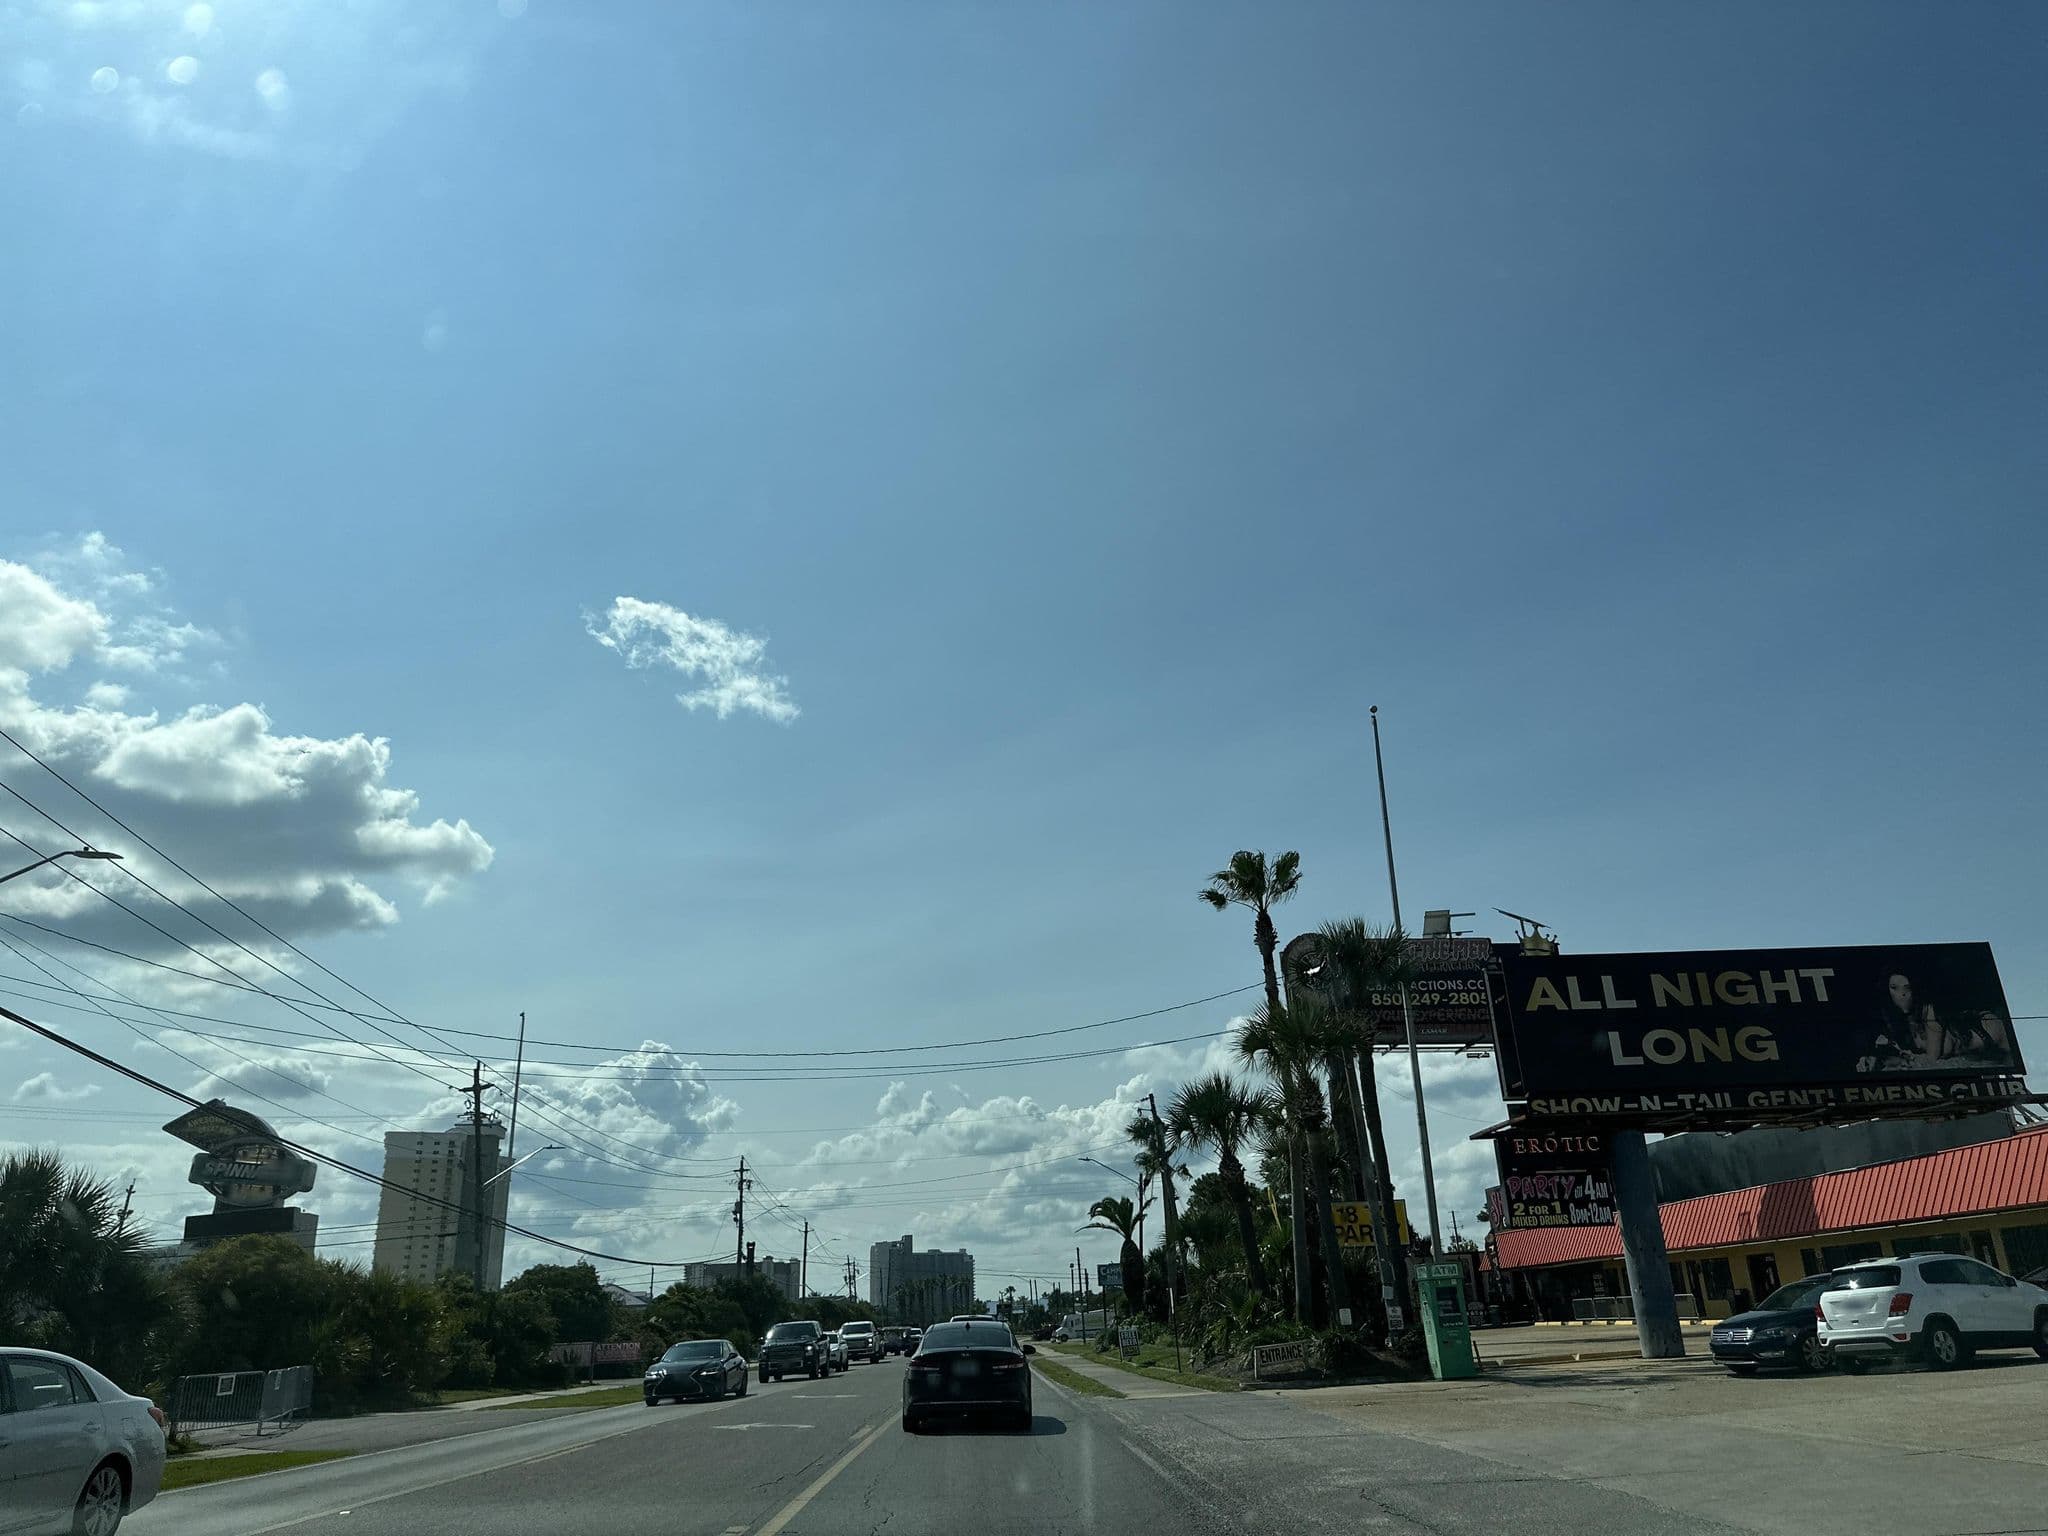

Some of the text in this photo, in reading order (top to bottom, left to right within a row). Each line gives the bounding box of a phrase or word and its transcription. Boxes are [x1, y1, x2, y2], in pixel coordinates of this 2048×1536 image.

[1525, 967, 1835, 1012] ALL NIGHT
[1608, 1025, 1780, 1067] LONG
[1512, 1136, 1600, 1154] EROTIC
[1506, 1174, 1576, 1200] PARTY
[1513, 1201, 1562, 1216] 2 FOR 1
[1569, 1202, 1612, 1224] 8PM-12AM
[1512, 1214, 1570, 1227] MIXED DRINKS
[1335, 1223, 1377, 1243] PAR
[1434, 1265, 1457, 1275] ATM
[1260, 1345, 1303, 1363] ENTRANCE
